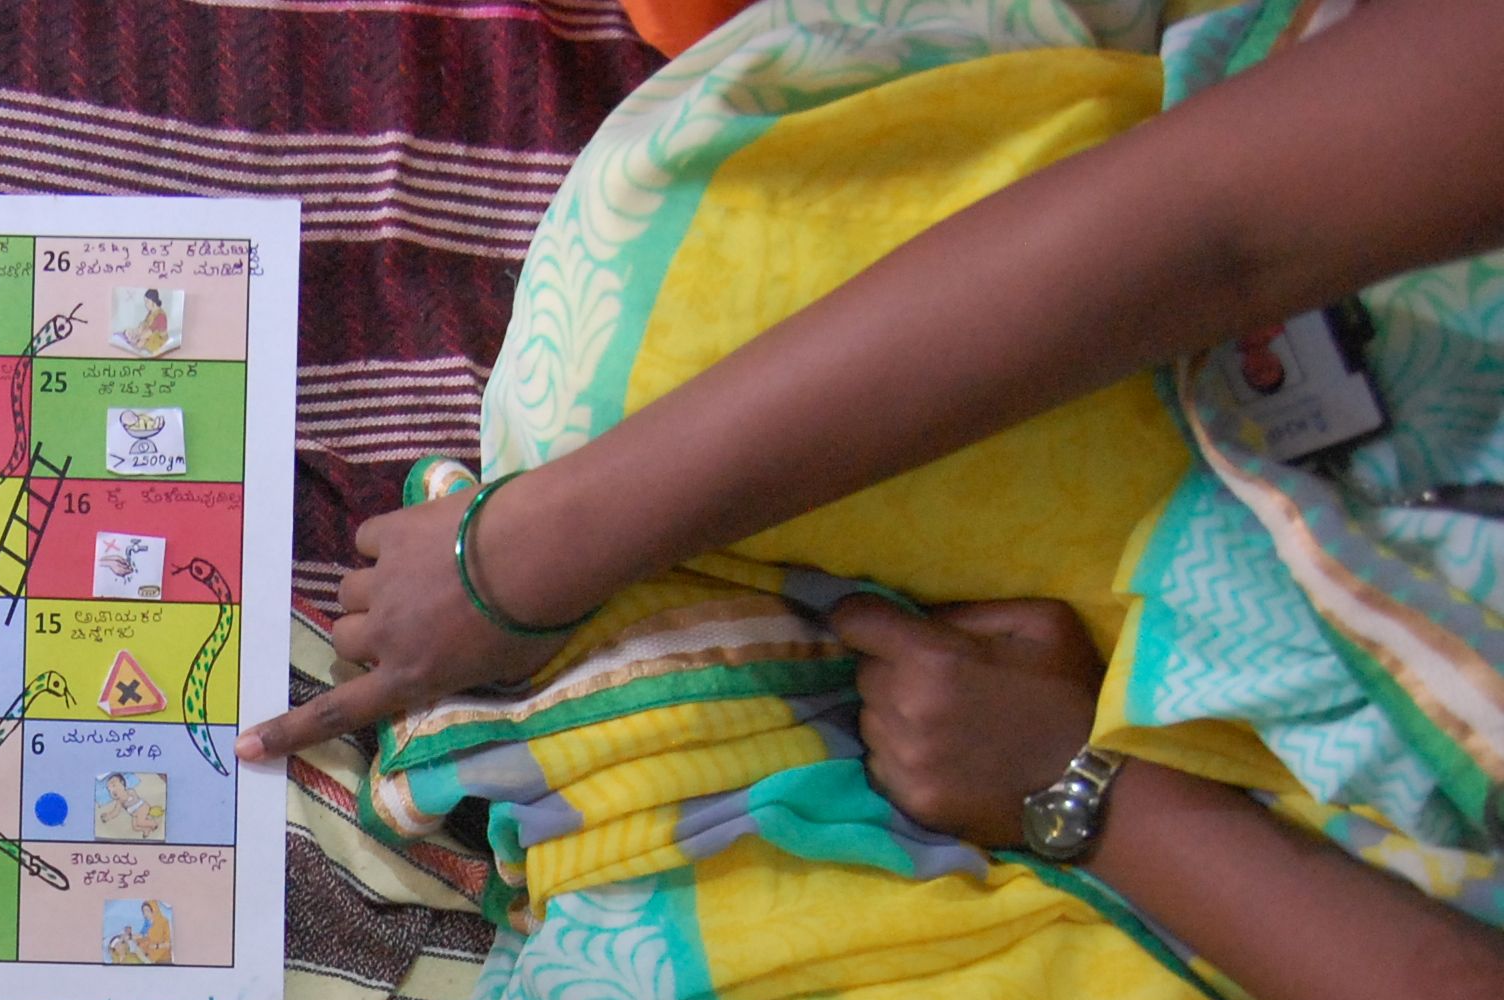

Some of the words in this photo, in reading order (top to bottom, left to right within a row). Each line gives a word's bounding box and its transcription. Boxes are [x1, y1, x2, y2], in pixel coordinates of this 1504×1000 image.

[43, 251, 71, 272] 26
[40, 371, 67, 393] 25
[64, 493, 91, 514] 16
[35, 613, 61, 634] 15
[32, 733, 45, 755] 6
[63, 728, 136, 744] ಮಗುವಿಗೆ
[29, 855, 41, 876] 5
